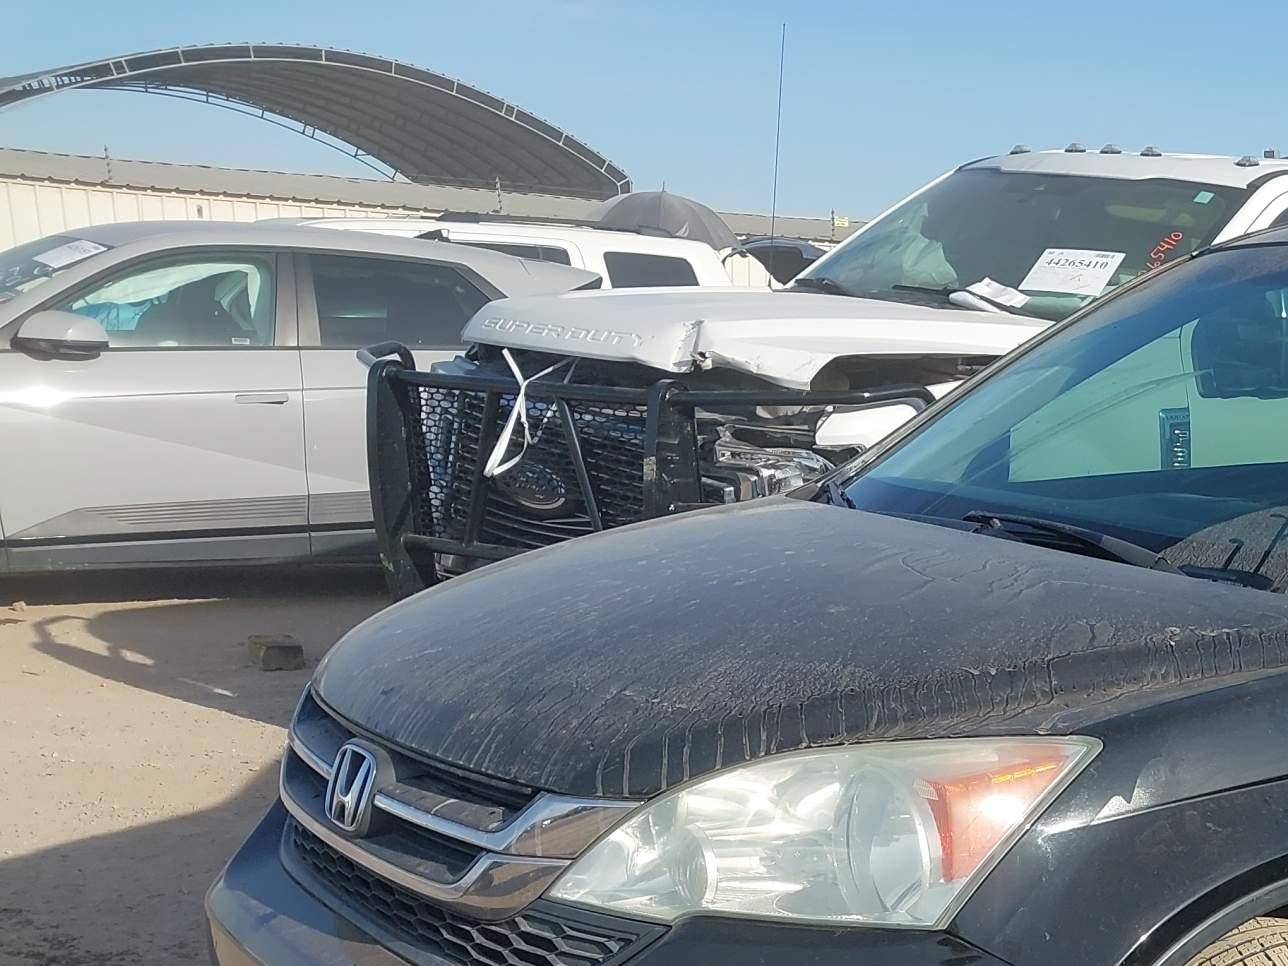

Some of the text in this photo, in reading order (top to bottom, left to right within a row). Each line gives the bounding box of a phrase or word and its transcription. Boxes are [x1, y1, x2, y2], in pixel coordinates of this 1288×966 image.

[1045, 257, 1110, 270] 44265410
[482, 316, 648, 348] SUPER DUTY
